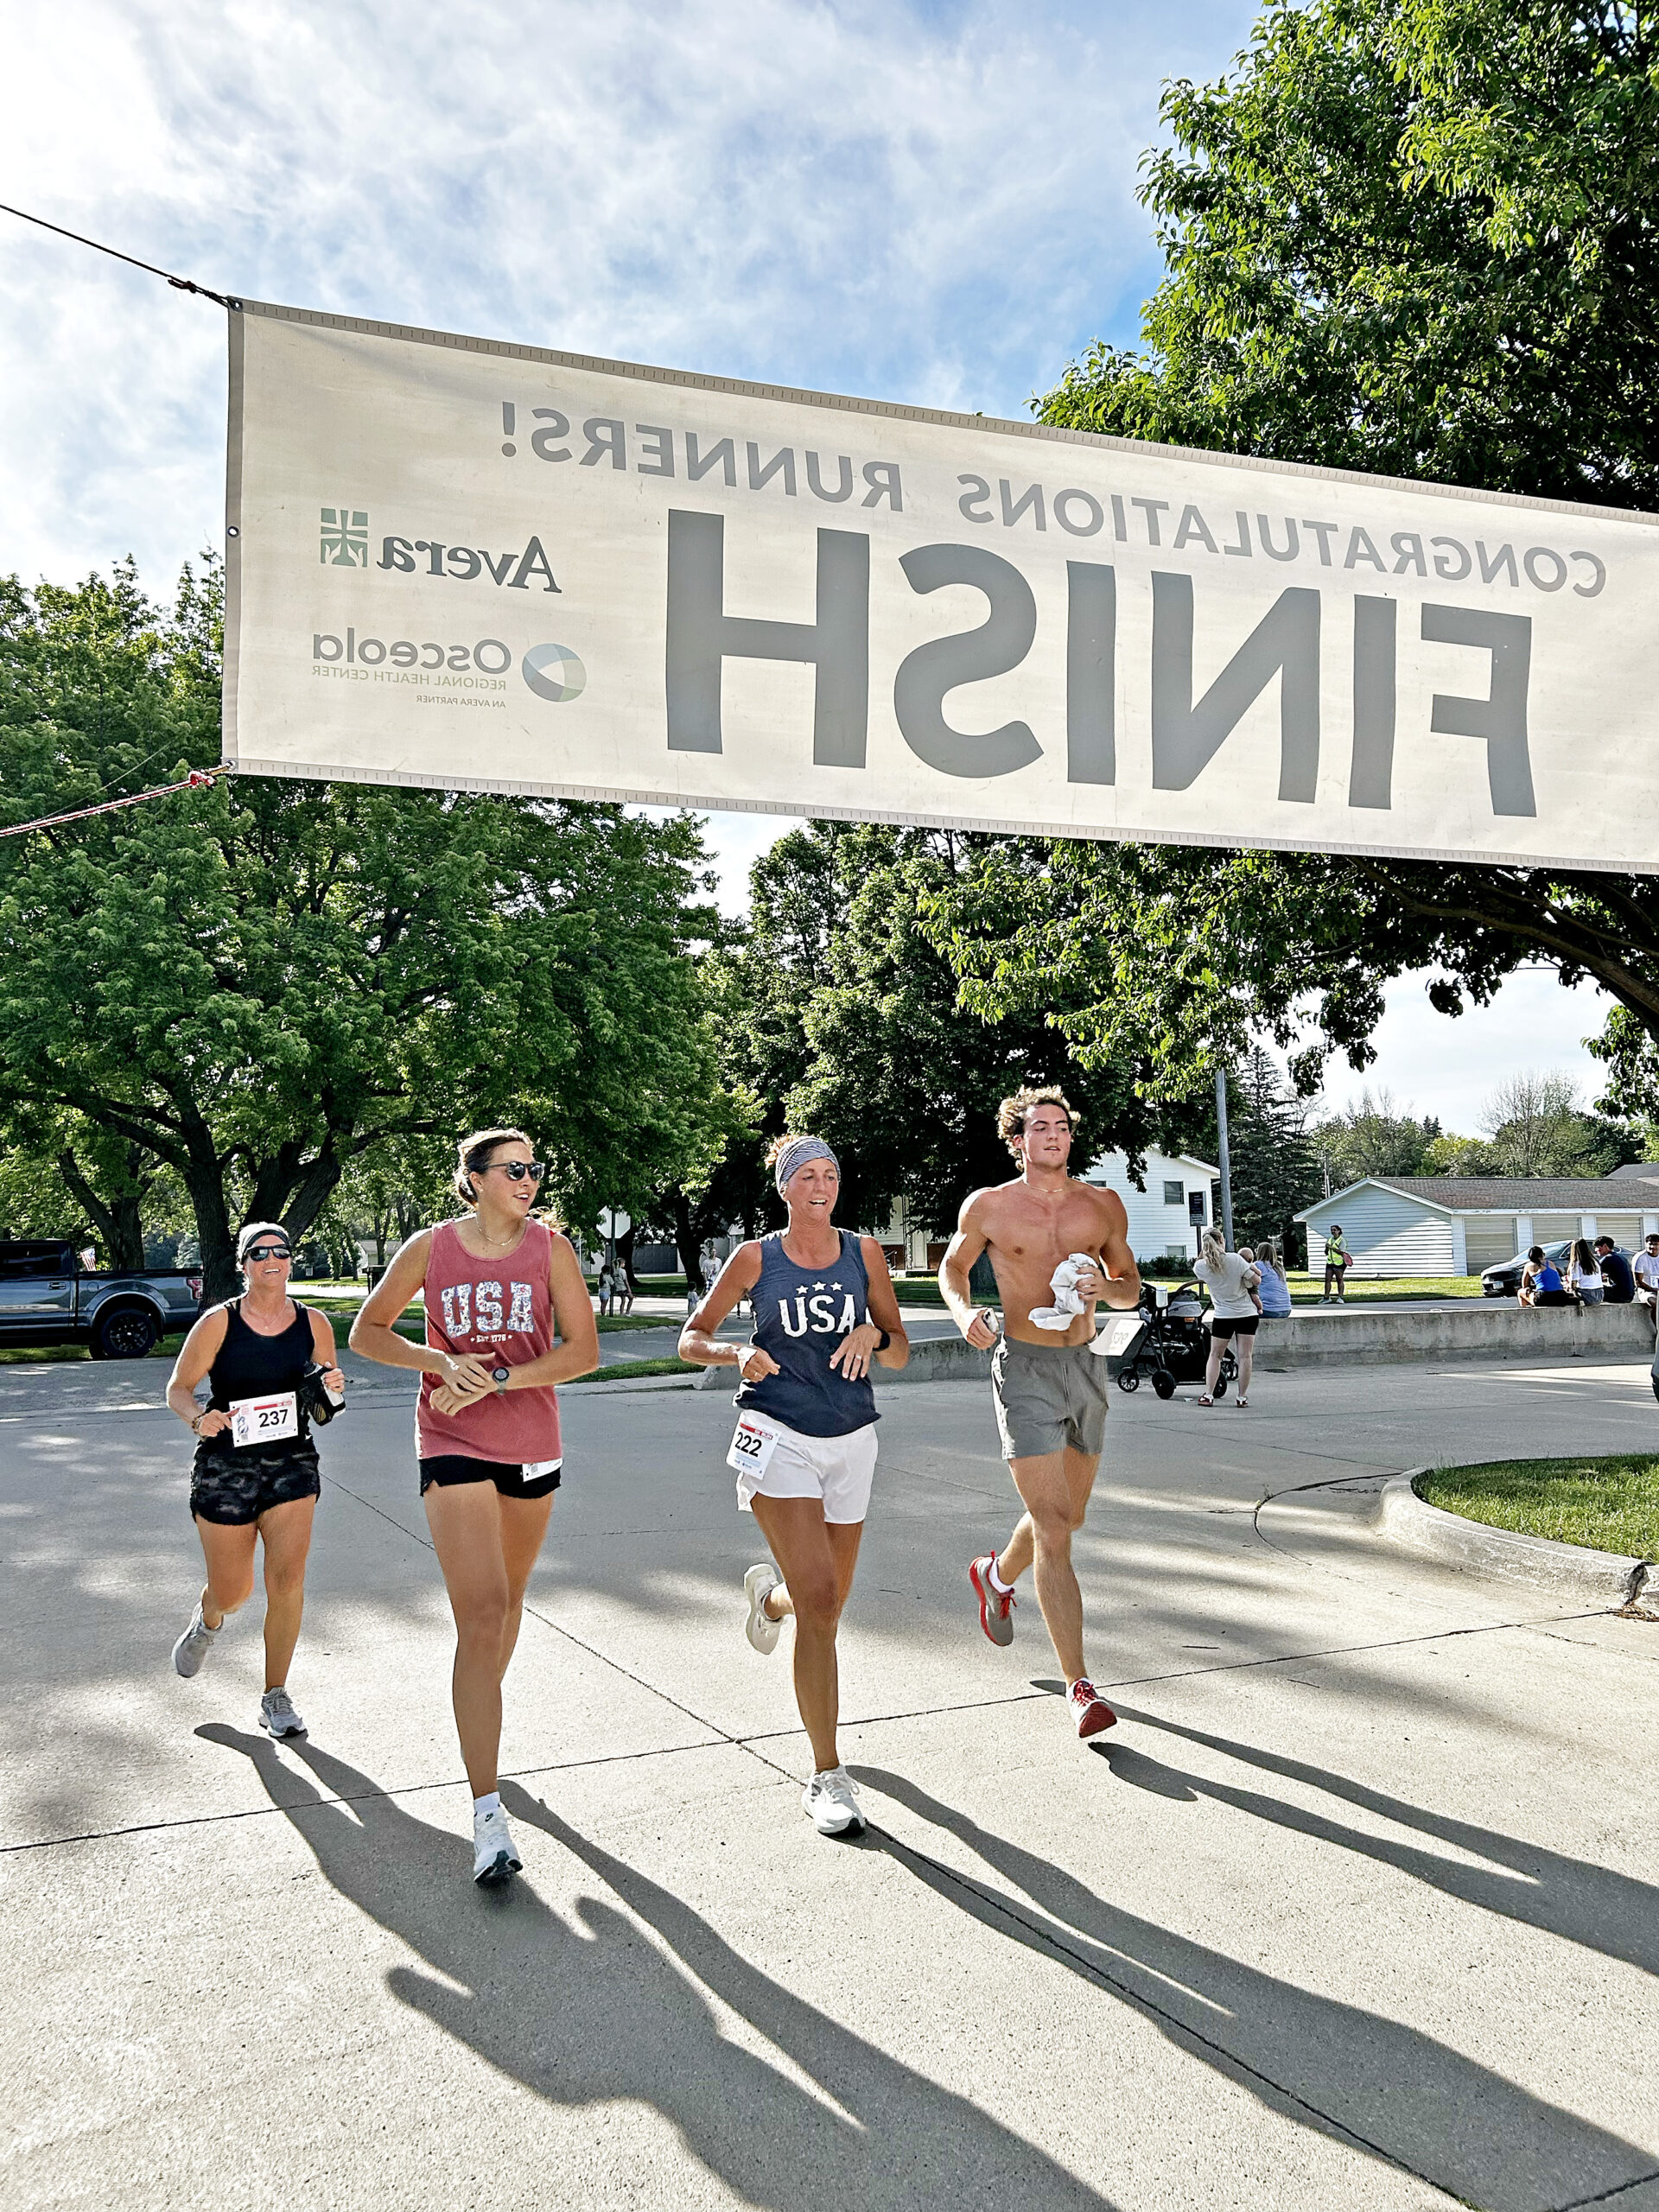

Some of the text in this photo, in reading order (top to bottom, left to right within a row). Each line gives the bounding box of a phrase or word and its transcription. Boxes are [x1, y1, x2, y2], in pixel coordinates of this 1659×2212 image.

[441, 1281, 534, 1338] USA
[778, 1294, 856, 1338] USA
[258, 1408, 289, 1428] 237
[734, 1431, 762, 1458] 222
